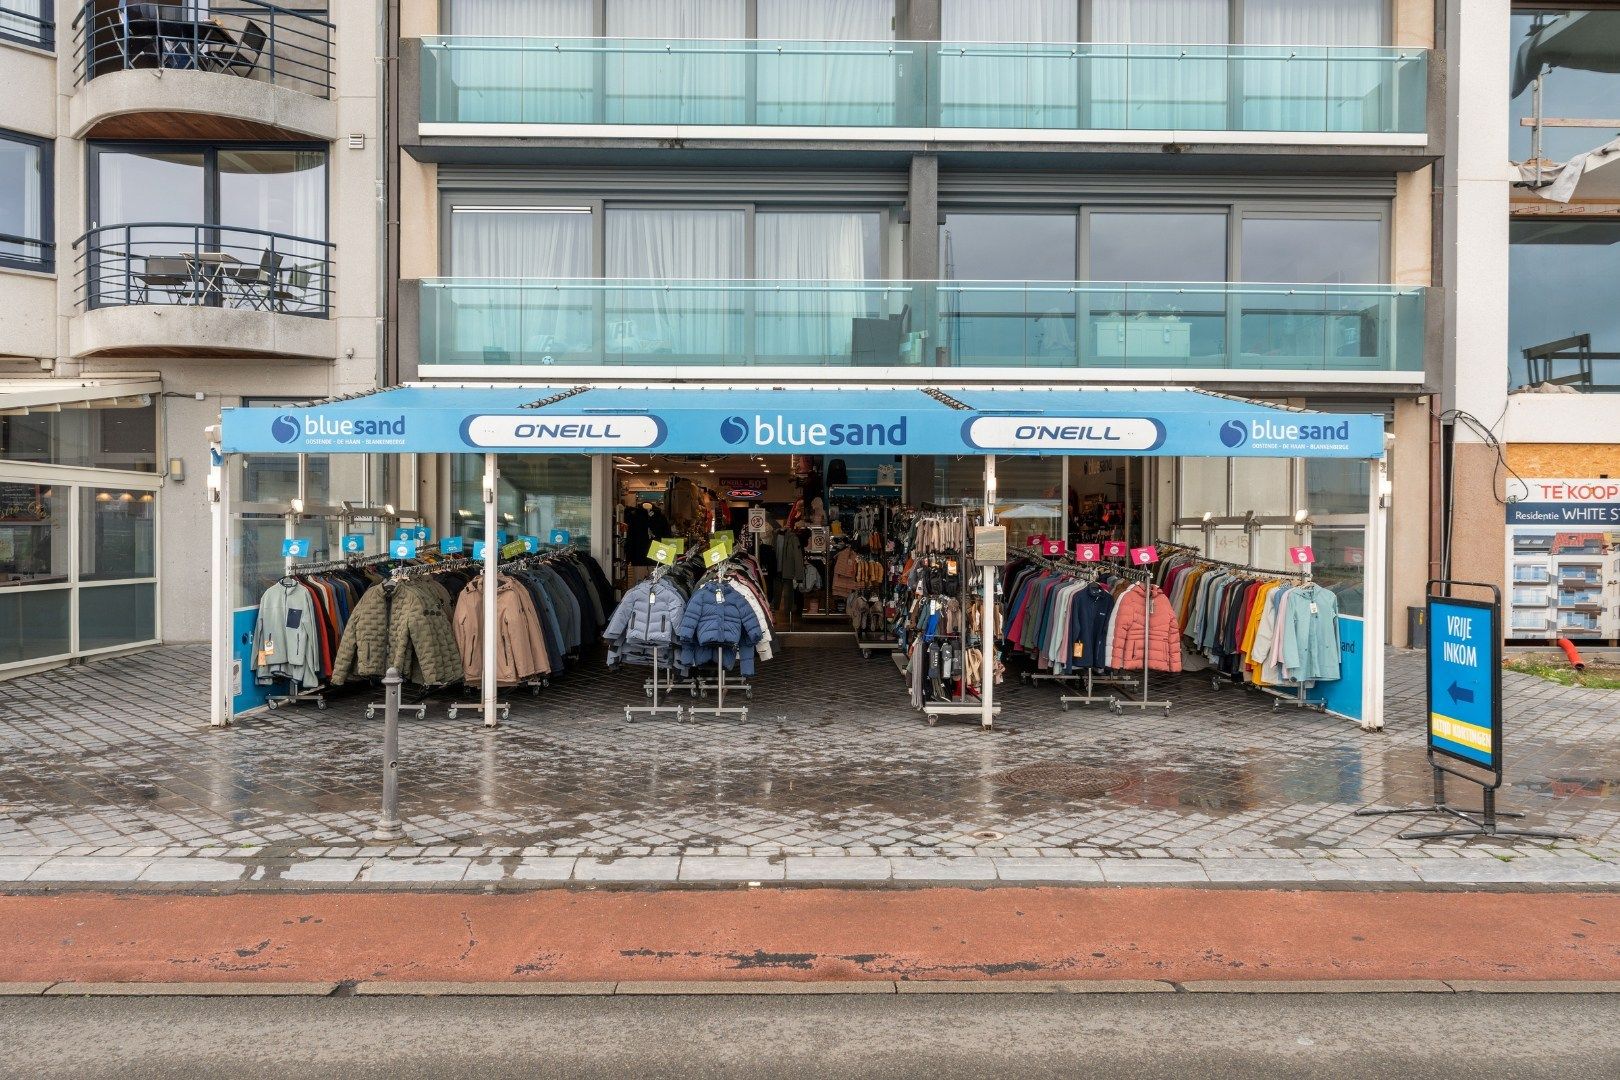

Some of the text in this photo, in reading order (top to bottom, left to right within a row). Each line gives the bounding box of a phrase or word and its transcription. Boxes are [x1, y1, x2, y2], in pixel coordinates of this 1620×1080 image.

[305, 414, 405, 435] bluesand
[514, 424, 621, 438] O'NEILL
[755, 414, 907, 446] bluesand
[1015, 425, 1121, 440] O'NEILL
[1252, 419, 1348, 440] bluesand
[1540, 485, 1619, 500] TE KOOP
[1515, 510, 1559, 520] Residentie
[1562, 507, 1607, 520] WHITE
[1447, 615, 1472, 641] VRIJE
[1443, 641, 1477, 668] INKOM
